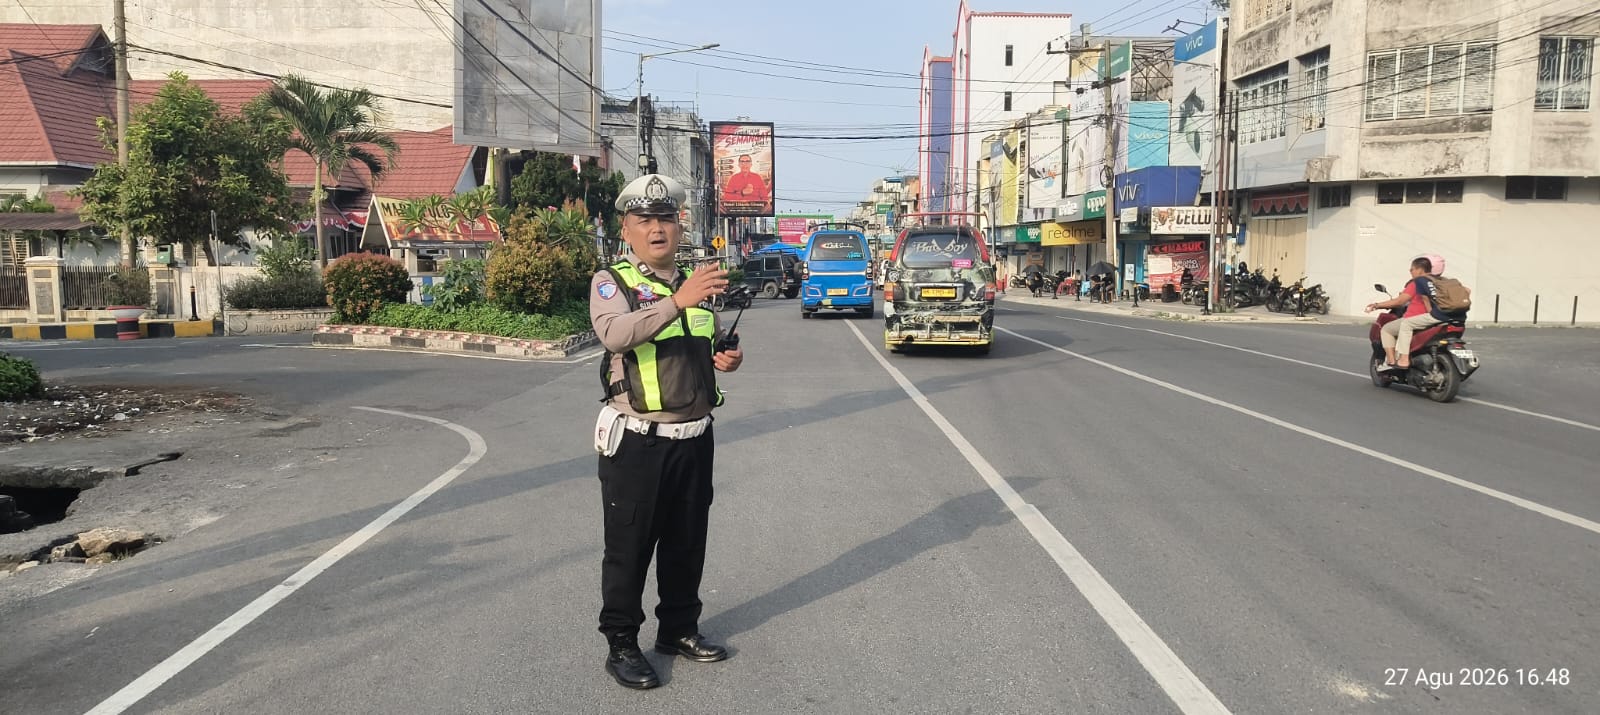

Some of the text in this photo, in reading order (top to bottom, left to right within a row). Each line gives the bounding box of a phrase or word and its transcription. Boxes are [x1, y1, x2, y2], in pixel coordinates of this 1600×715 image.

[1185, 35, 1204, 52] vivo
[1087, 195, 1106, 213] oppo
[1048, 226, 1096, 239] realme
